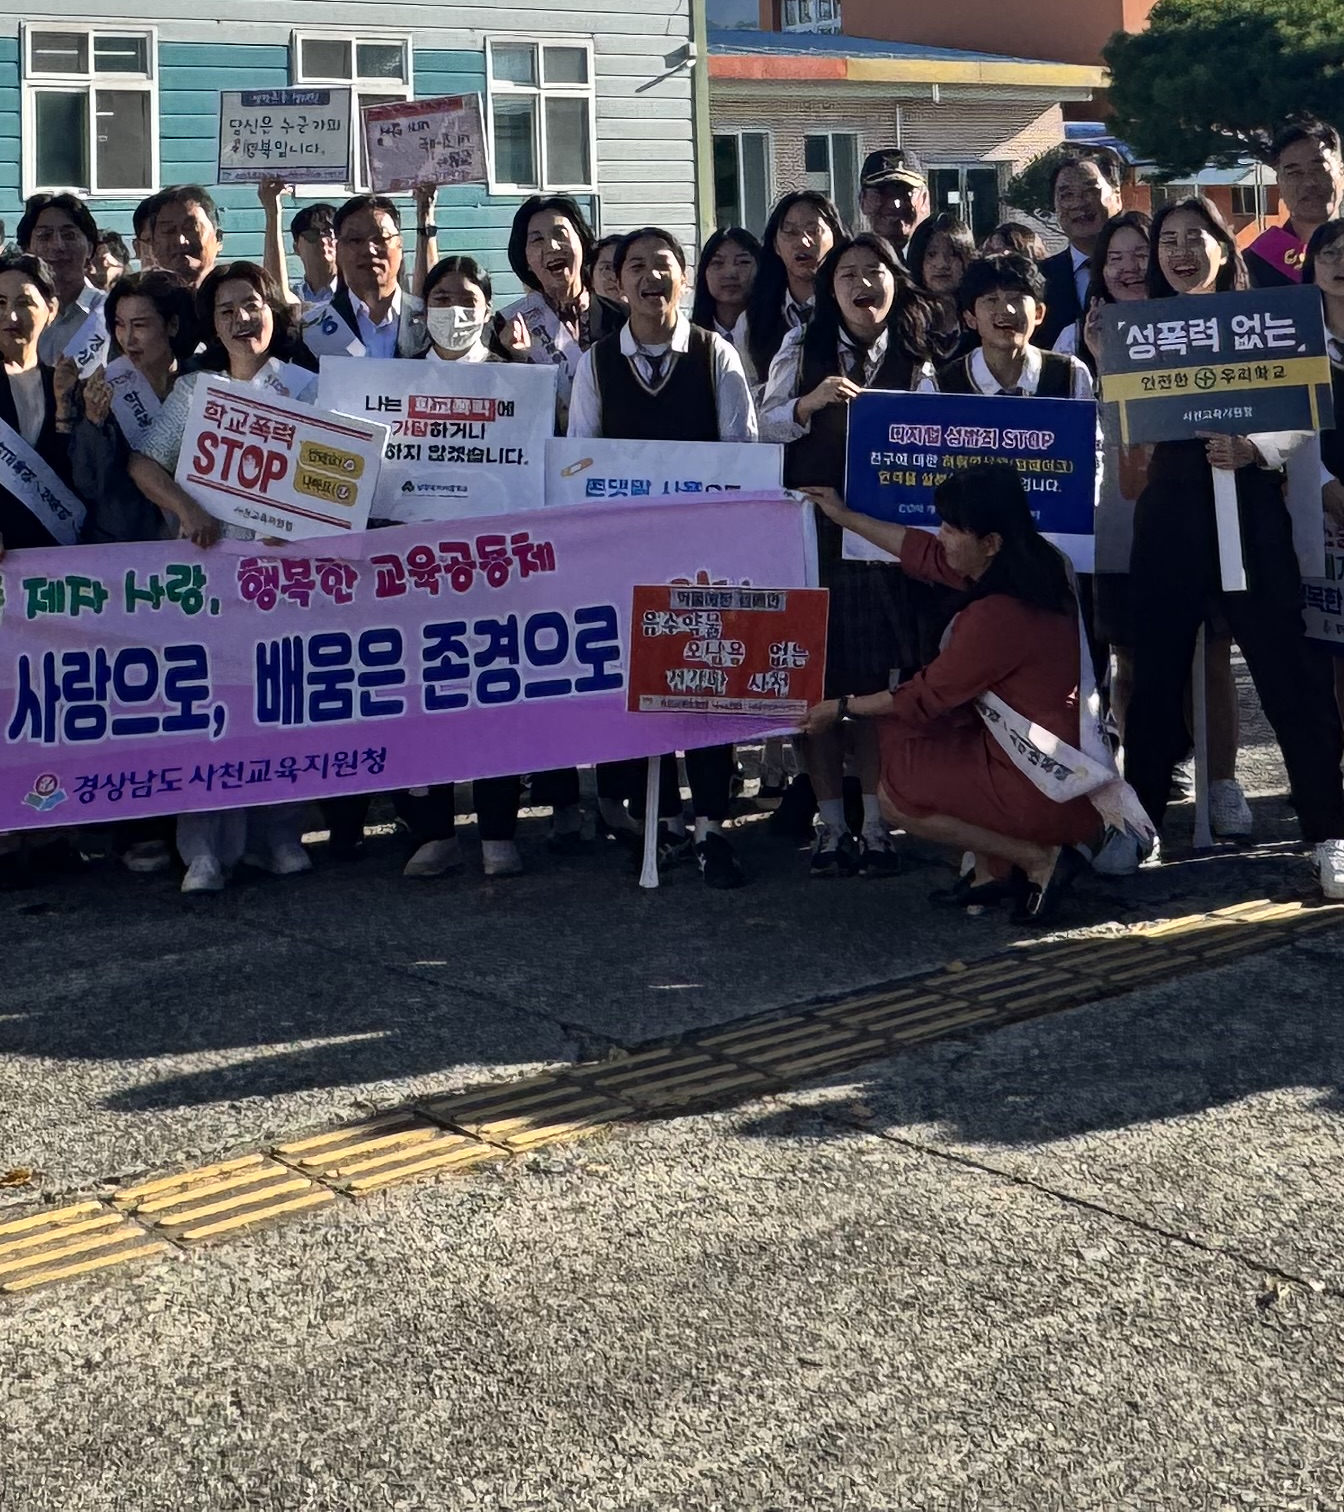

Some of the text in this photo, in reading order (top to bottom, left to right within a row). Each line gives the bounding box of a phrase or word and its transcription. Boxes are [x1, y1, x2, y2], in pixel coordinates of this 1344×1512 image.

[204, 399, 296, 450] 학교폭력
[365, 395, 402, 412] 나는
[193, 431, 288, 494] STOP
[1002, 430, 1055, 450] STOP
[23, 575, 109, 620] 제자
[238, 557, 359, 611] 행복한
[370, 532, 556, 598] 교육공동체
[1303, 583, 1343, 616] 복한
[8, 643, 226, 744] 사랑으로,
[256, 627, 406, 726] 배움은
[422, 604, 624, 710] 존경으로
